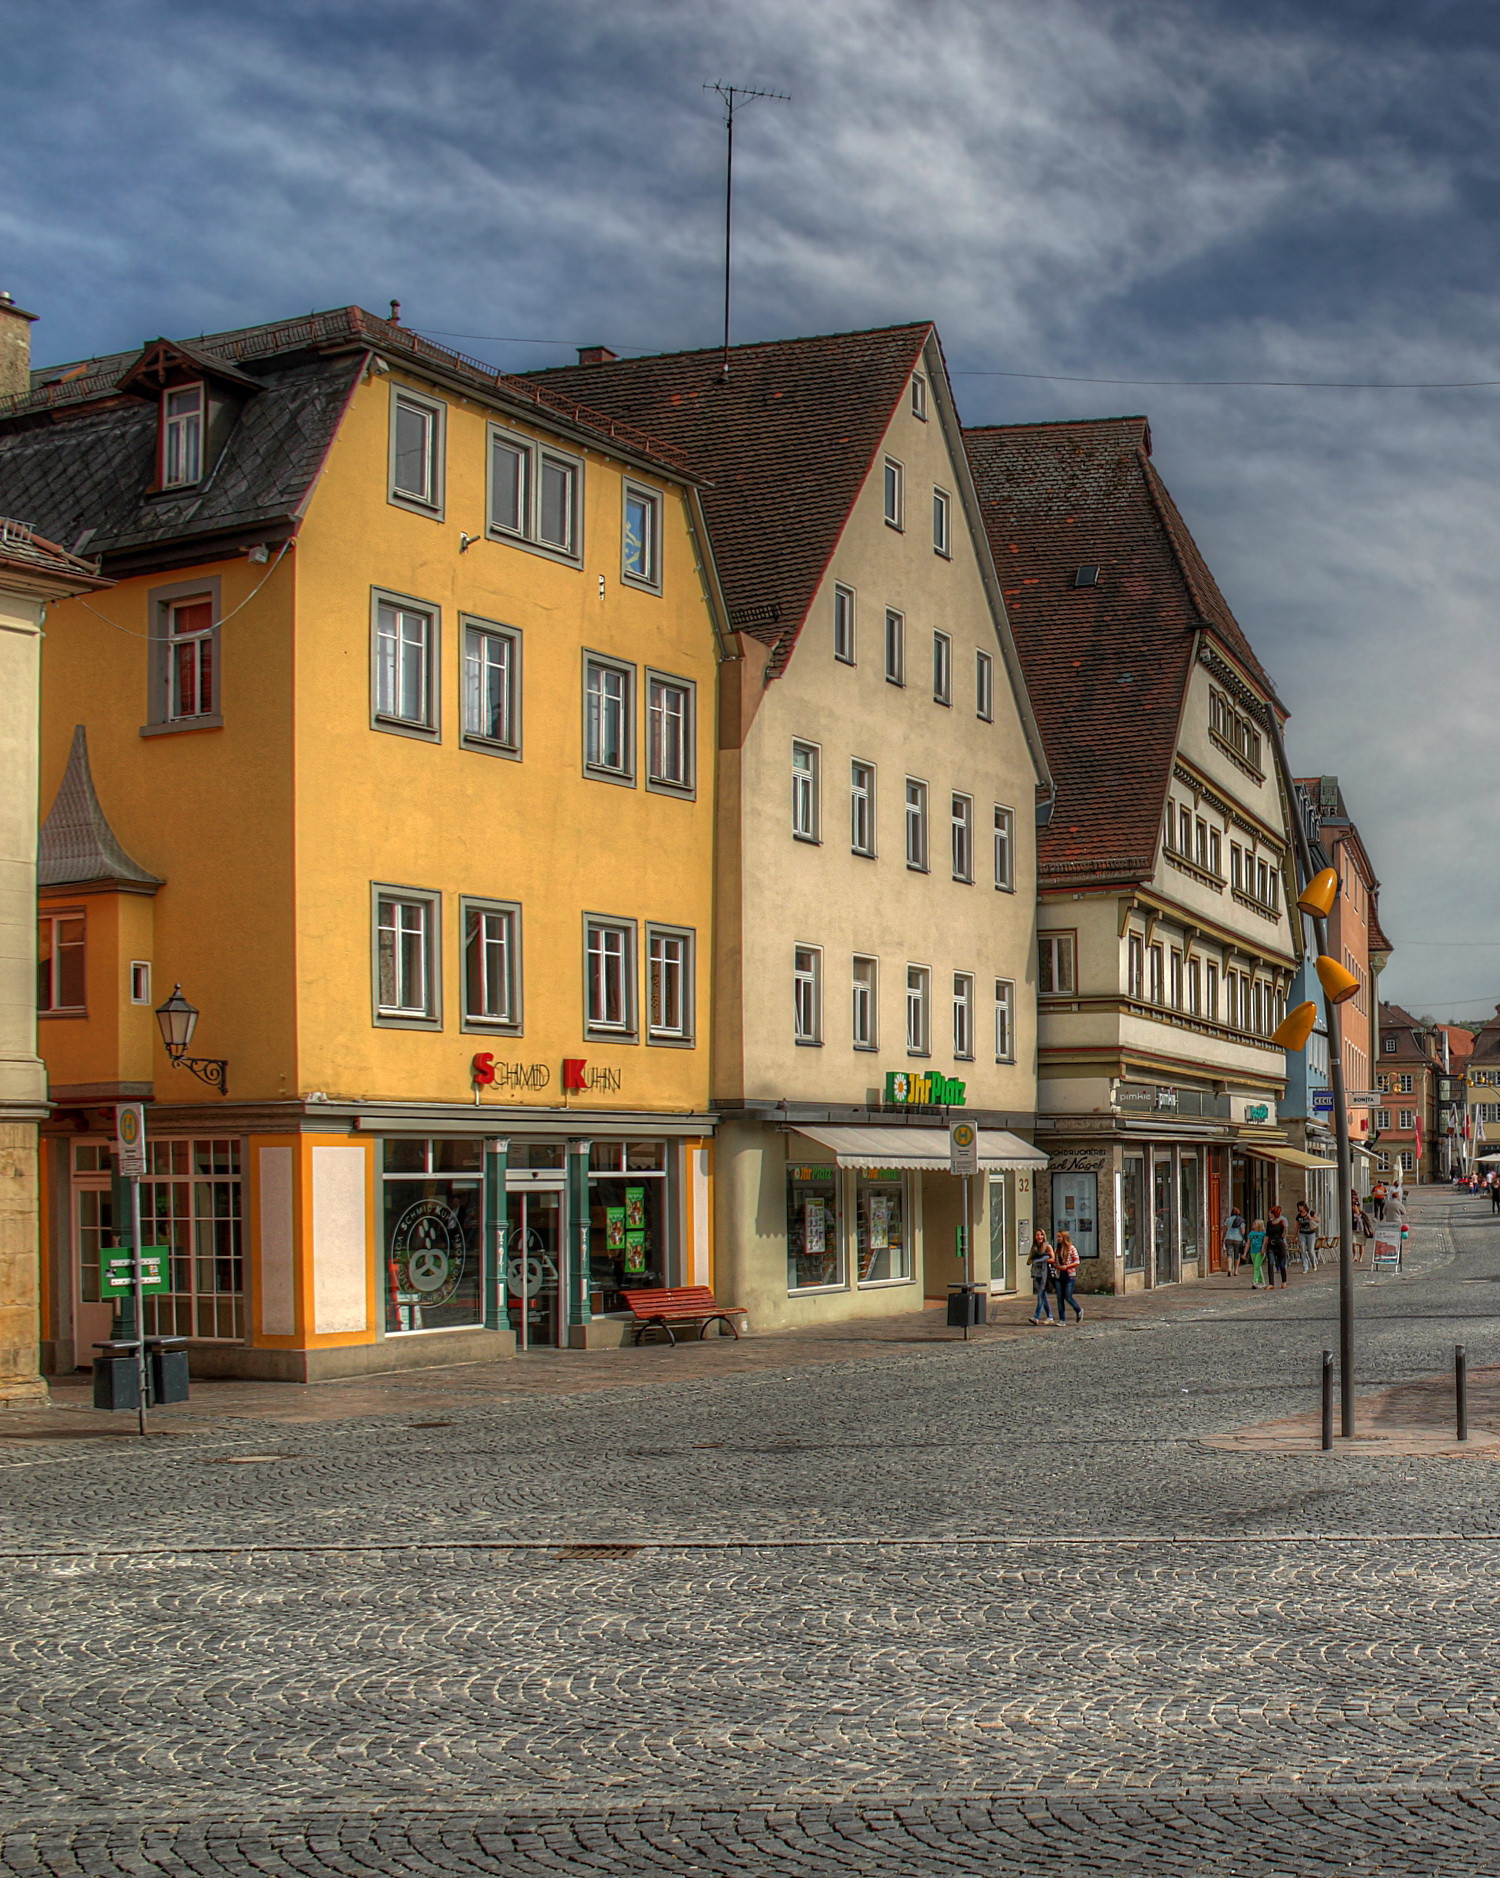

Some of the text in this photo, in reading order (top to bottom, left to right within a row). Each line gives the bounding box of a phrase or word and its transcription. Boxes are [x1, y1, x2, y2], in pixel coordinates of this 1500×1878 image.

[473, 1052, 621, 1090] SCHMID KUHN
[1119, 1089, 1152, 1102] pimkie
[1066, 1156, 1106, 1171] Nagel
[1018, 1178, 1029, 1192] 32
[401, 1204, 433, 1231] SCHMID
